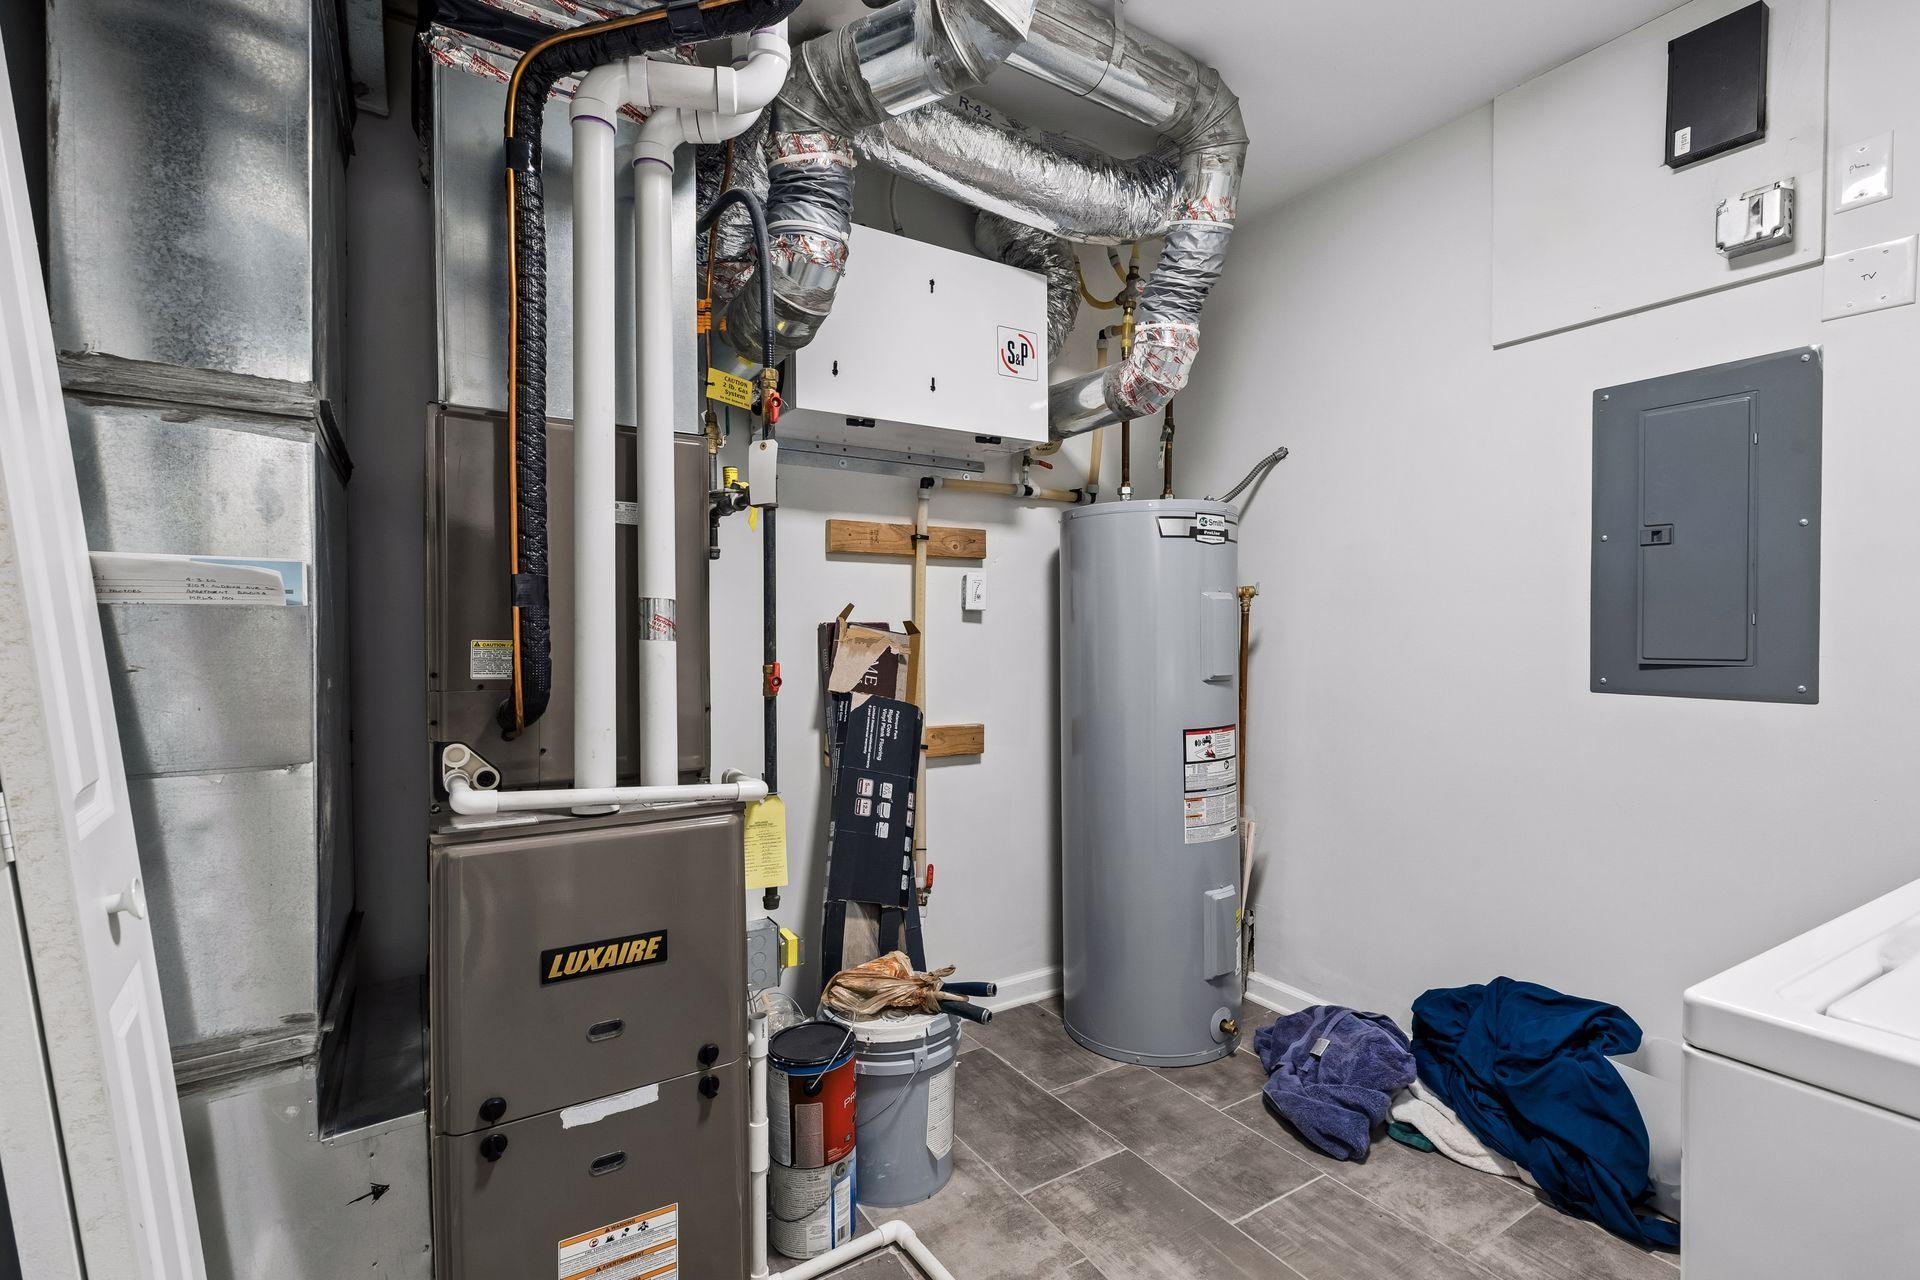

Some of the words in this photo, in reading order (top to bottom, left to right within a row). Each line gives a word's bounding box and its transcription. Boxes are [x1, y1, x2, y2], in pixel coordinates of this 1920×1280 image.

[959, 95, 992, 121] R-4.2
[1860, 271, 1877, 280] TV
[1007, 340, 1028, 366] S&P
[724, 376, 748, 388] CAUTION
[724, 389, 746, 400] System
[737, 387, 748, 395] Gas
[876, 737, 885, 761] Flooring
[548, 935, 663, 979] LUXAIRE
[610, 1219, 636, 1231] WARNING
